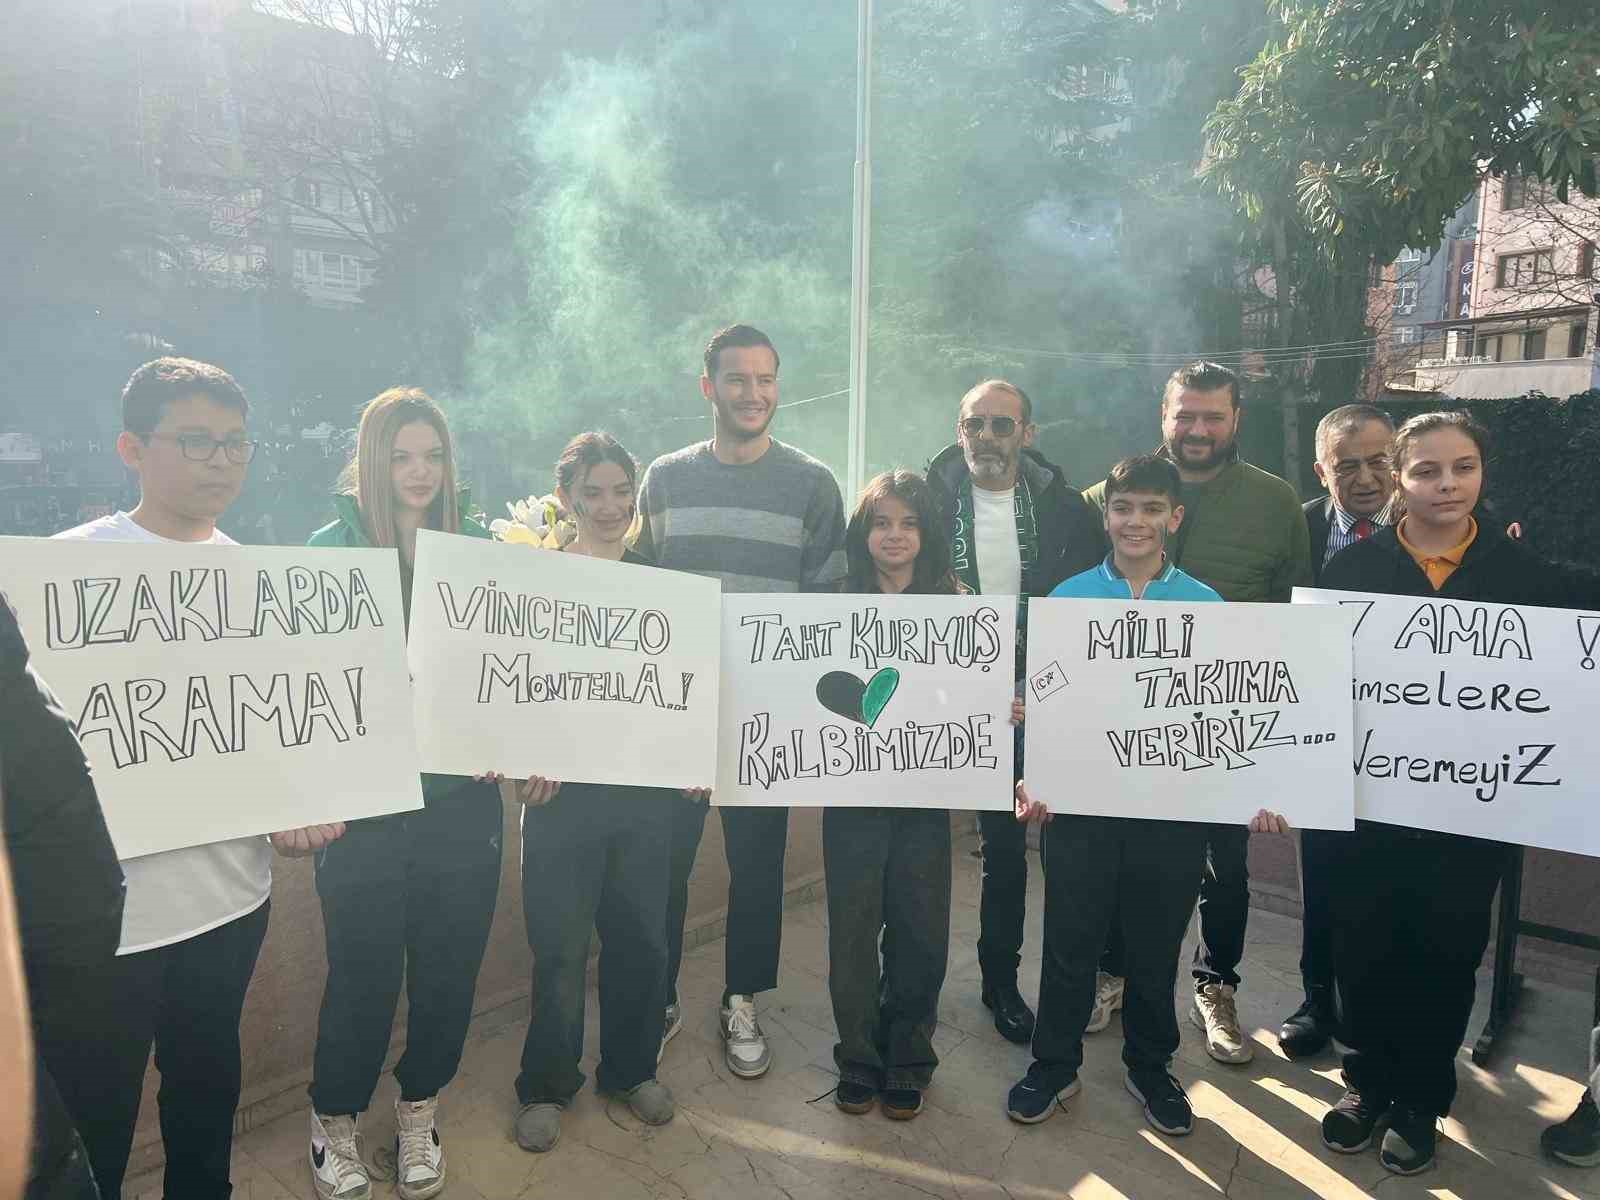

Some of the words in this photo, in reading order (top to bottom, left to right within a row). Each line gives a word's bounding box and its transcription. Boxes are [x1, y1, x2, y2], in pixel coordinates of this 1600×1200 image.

[45, 566, 384, 650] UZAKLARDA
[437, 580, 671, 656] VİNCENZO
[741, 613, 841, 664] TAHT
[850, 606, 1001, 673] KURMUŞ
[1087, 610, 1195, 660] MİLLİ
[1394, 603, 1533, 660] AMA
[1135, 659, 1299, 708] TAKIMA
[1352, 670, 1551, 713] imselere
[76, 667, 367, 769] ARAMA!
[739, 712, 998, 790] KALBİMİZDE
